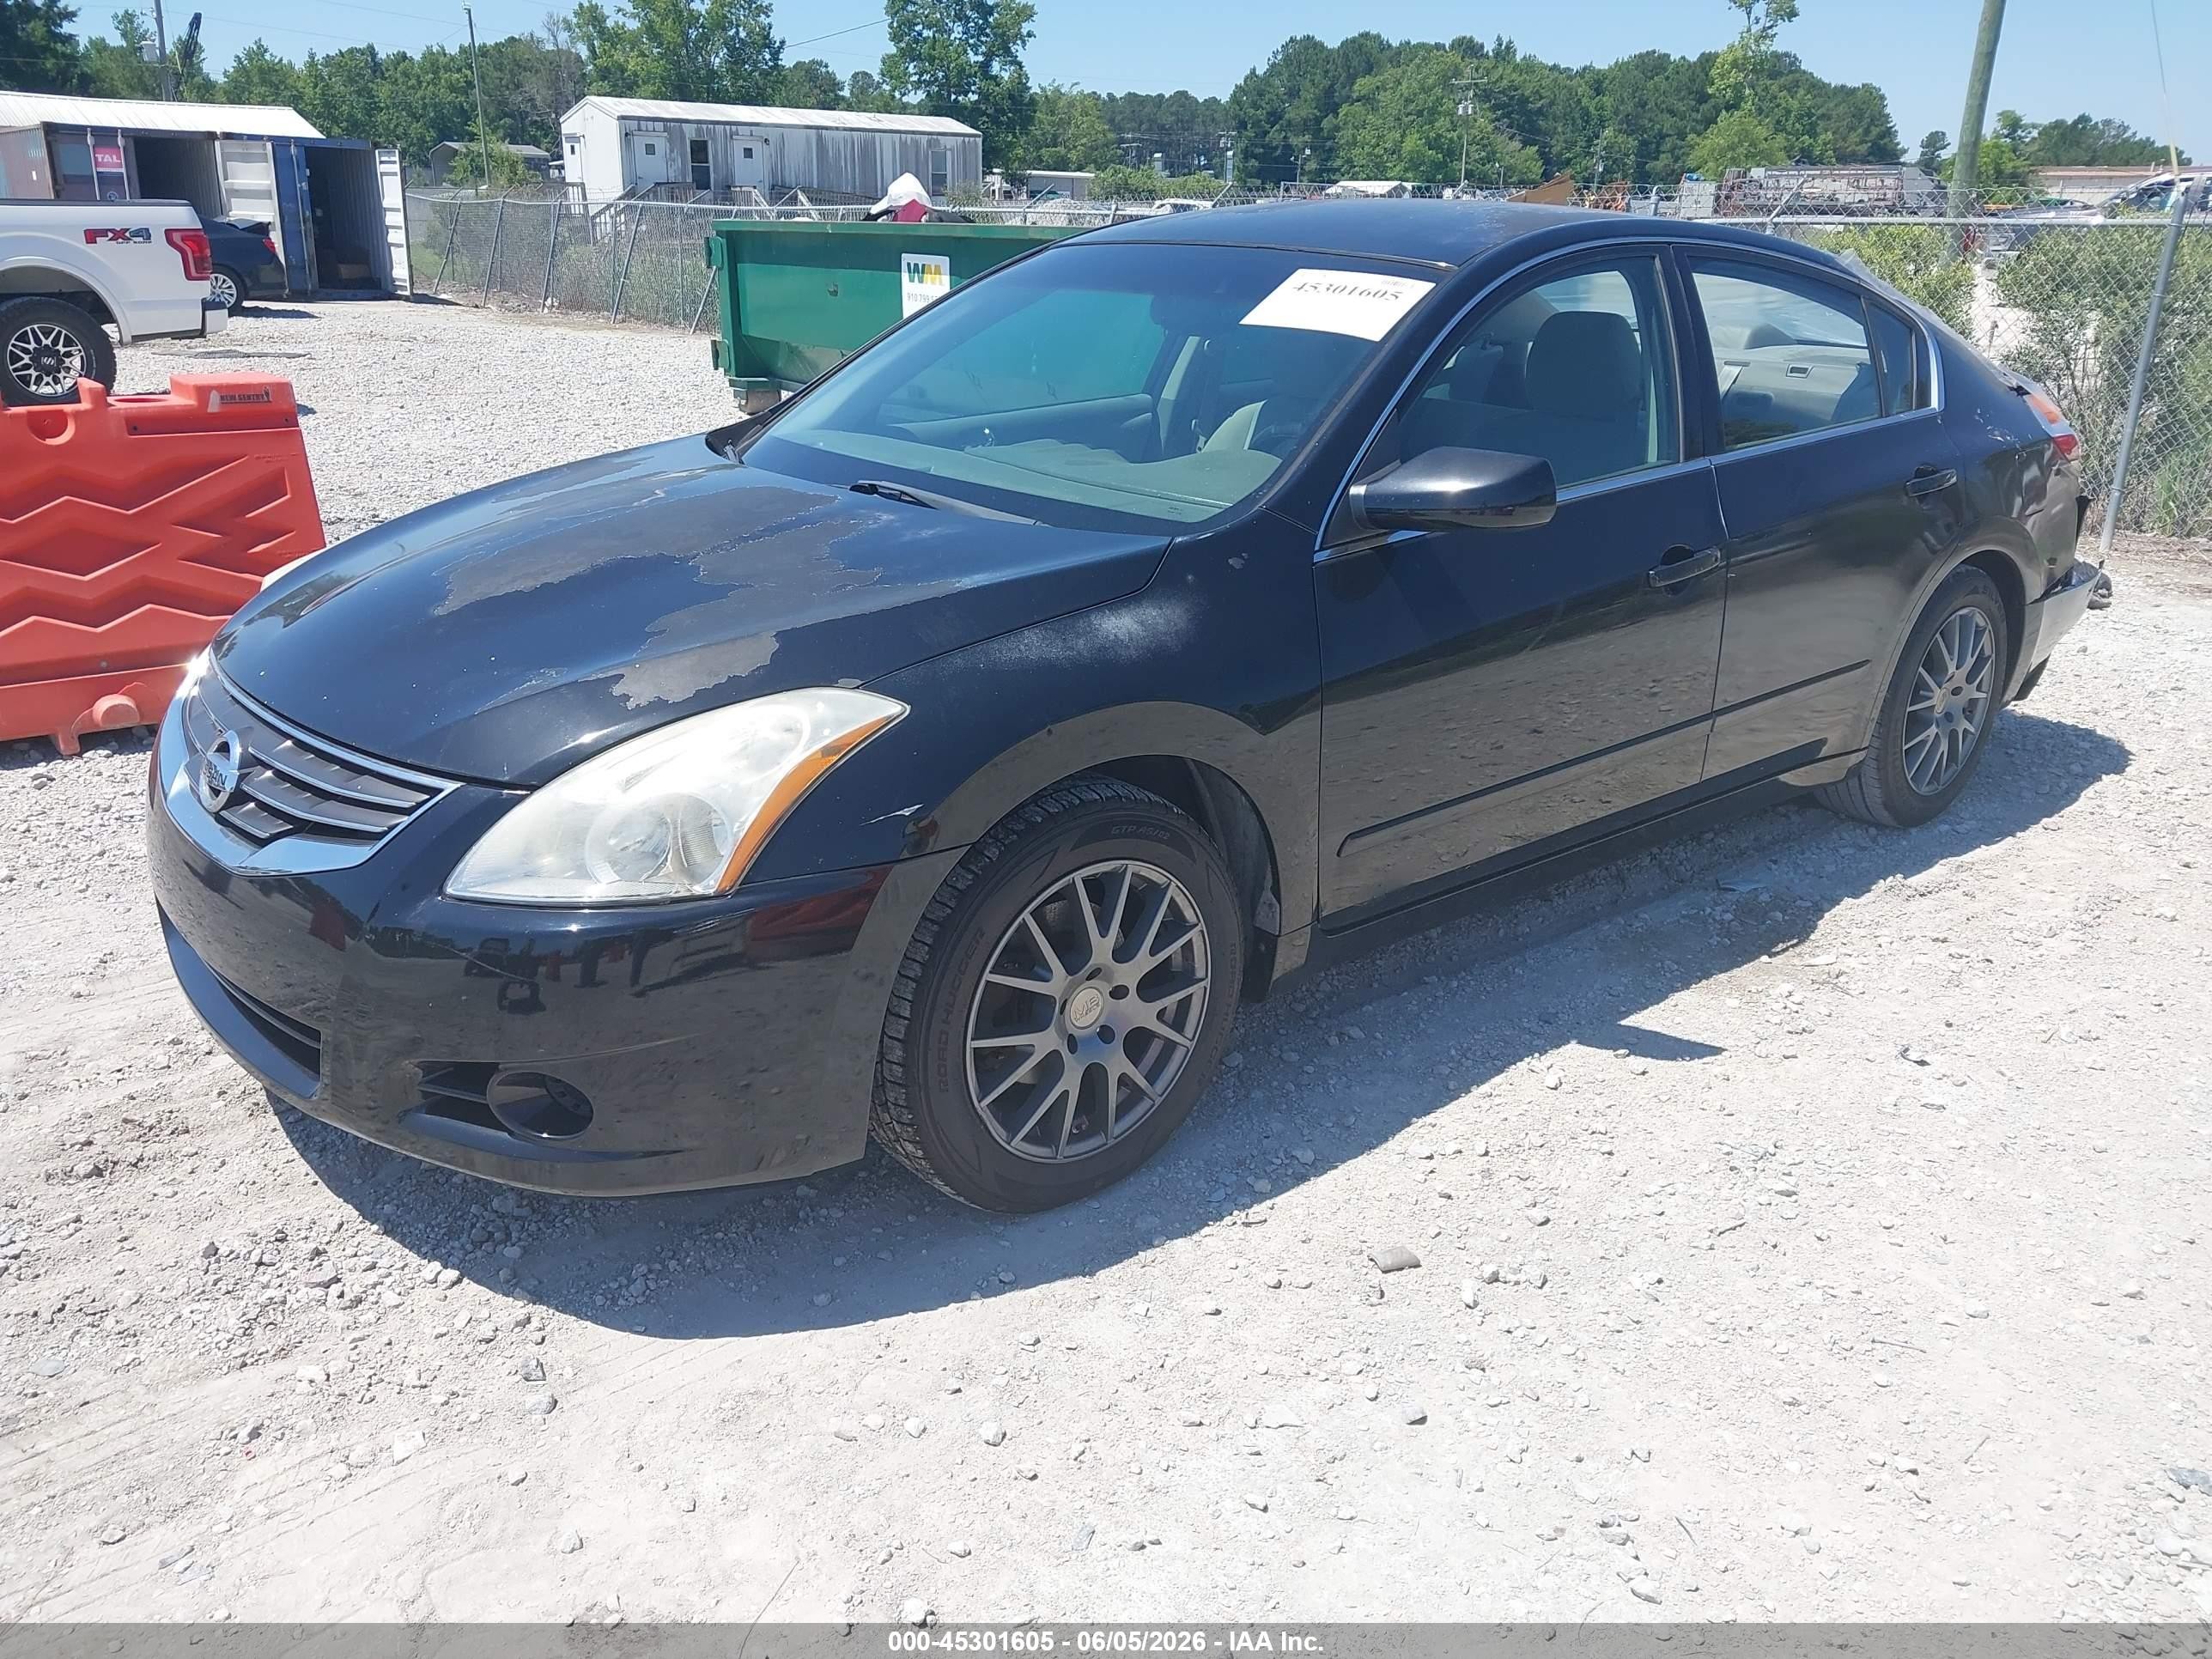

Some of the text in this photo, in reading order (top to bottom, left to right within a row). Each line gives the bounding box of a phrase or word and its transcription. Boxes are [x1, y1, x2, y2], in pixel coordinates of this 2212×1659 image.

[94, 154, 121, 163] TAL
[83, 227, 151, 244] FX4
[906, 261, 944, 285] WM
[1292, 282, 1403, 301] 45301605
